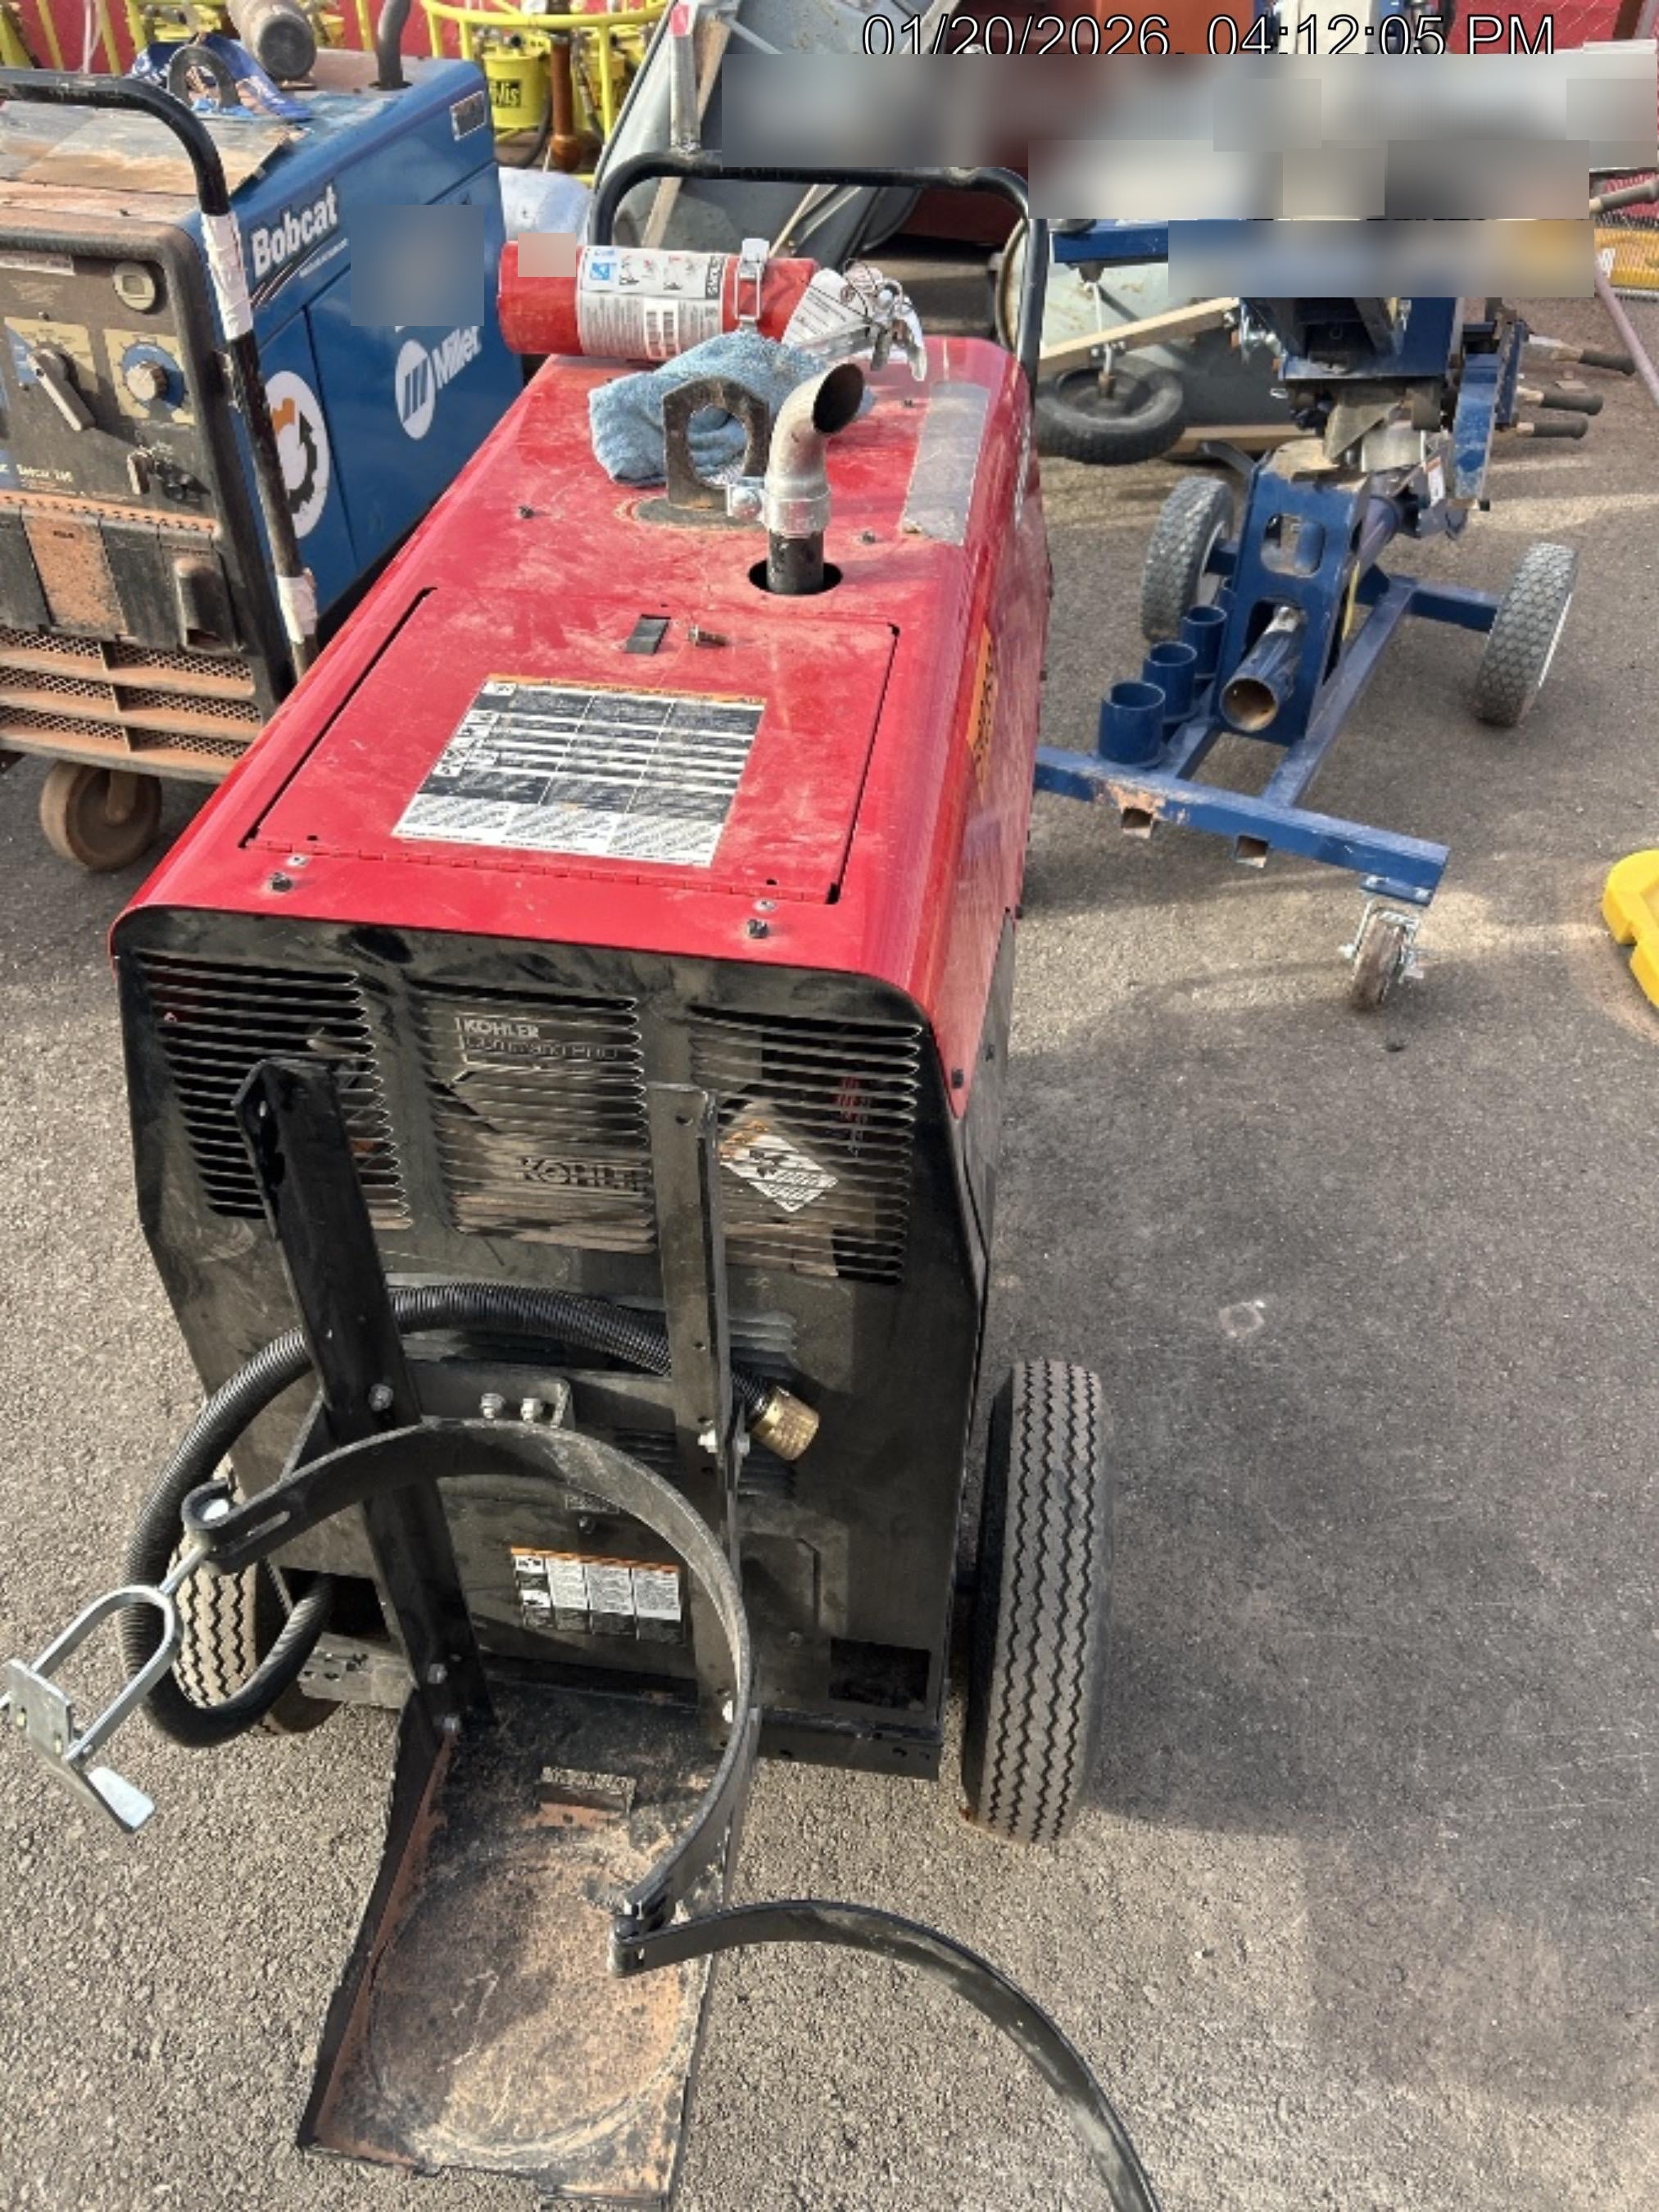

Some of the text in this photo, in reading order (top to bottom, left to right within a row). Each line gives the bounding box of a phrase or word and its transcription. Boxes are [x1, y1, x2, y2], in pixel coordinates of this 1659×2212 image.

[252, 183, 338, 279] Bobcat
[432, 325, 482, 389] Miller
[464, 1019, 540, 1038] KOHLER
